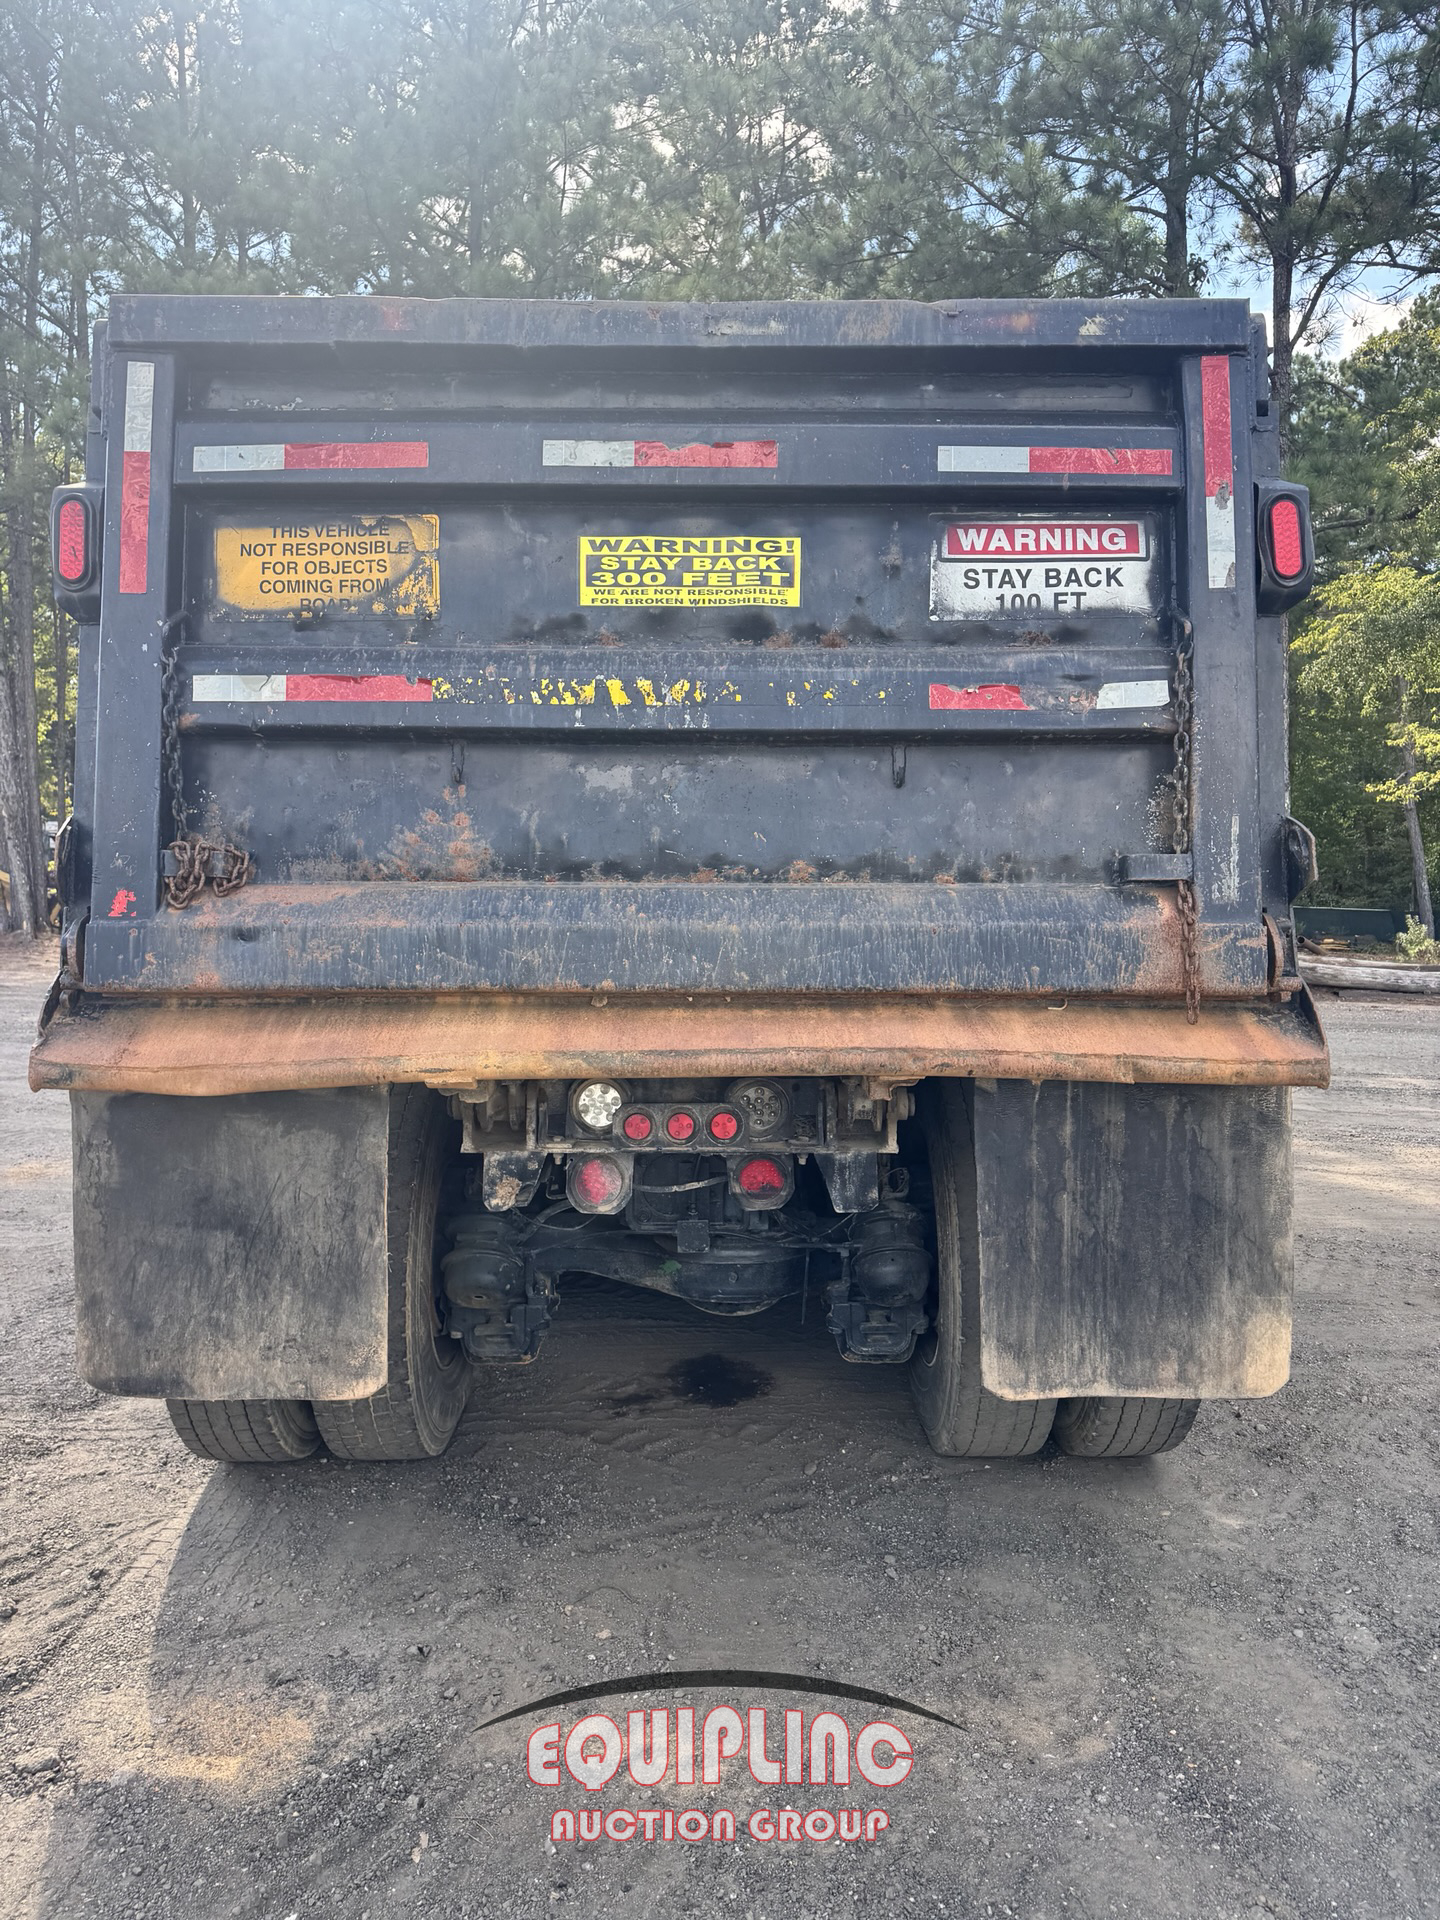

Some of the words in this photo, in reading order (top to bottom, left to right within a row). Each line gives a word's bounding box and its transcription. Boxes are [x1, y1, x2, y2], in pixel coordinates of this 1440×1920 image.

[270, 525, 309, 538] THIS
[314, 524, 390, 538] VEHICLE
[588, 539, 795, 553] WARNING!
[956, 527, 1127, 552] WARNING
[240, 543, 277, 557] NOT
[282, 541, 410, 557] RESPONSIBLE
[261, 561, 298, 575] FOR
[304, 558, 388, 575] OBJECTS
[600, 556, 682, 571] STAY
[692, 556, 781, 571] BACK
[591, 571, 667, 586] 300
[682, 571, 790, 586] FEET
[963, 568, 1032, 590] STAY
[1044, 567, 1124, 588] BACK
[259, 579, 333, 595] COMING
[339, 578, 390, 594] FROM
[593, 588, 616, 596] WE
[620, 588, 649, 596] ARE
[653, 588, 683, 596] NOT
[687, 587, 786, 596] RESPONSIBLE
[591, 597, 620, 605] FOR
[624, 597, 684, 605] BROKEN
[688, 597, 789, 606] WINDSHIELDS
[995, 593, 1042, 611] 100
[1053, 591, 1087, 613] FT
